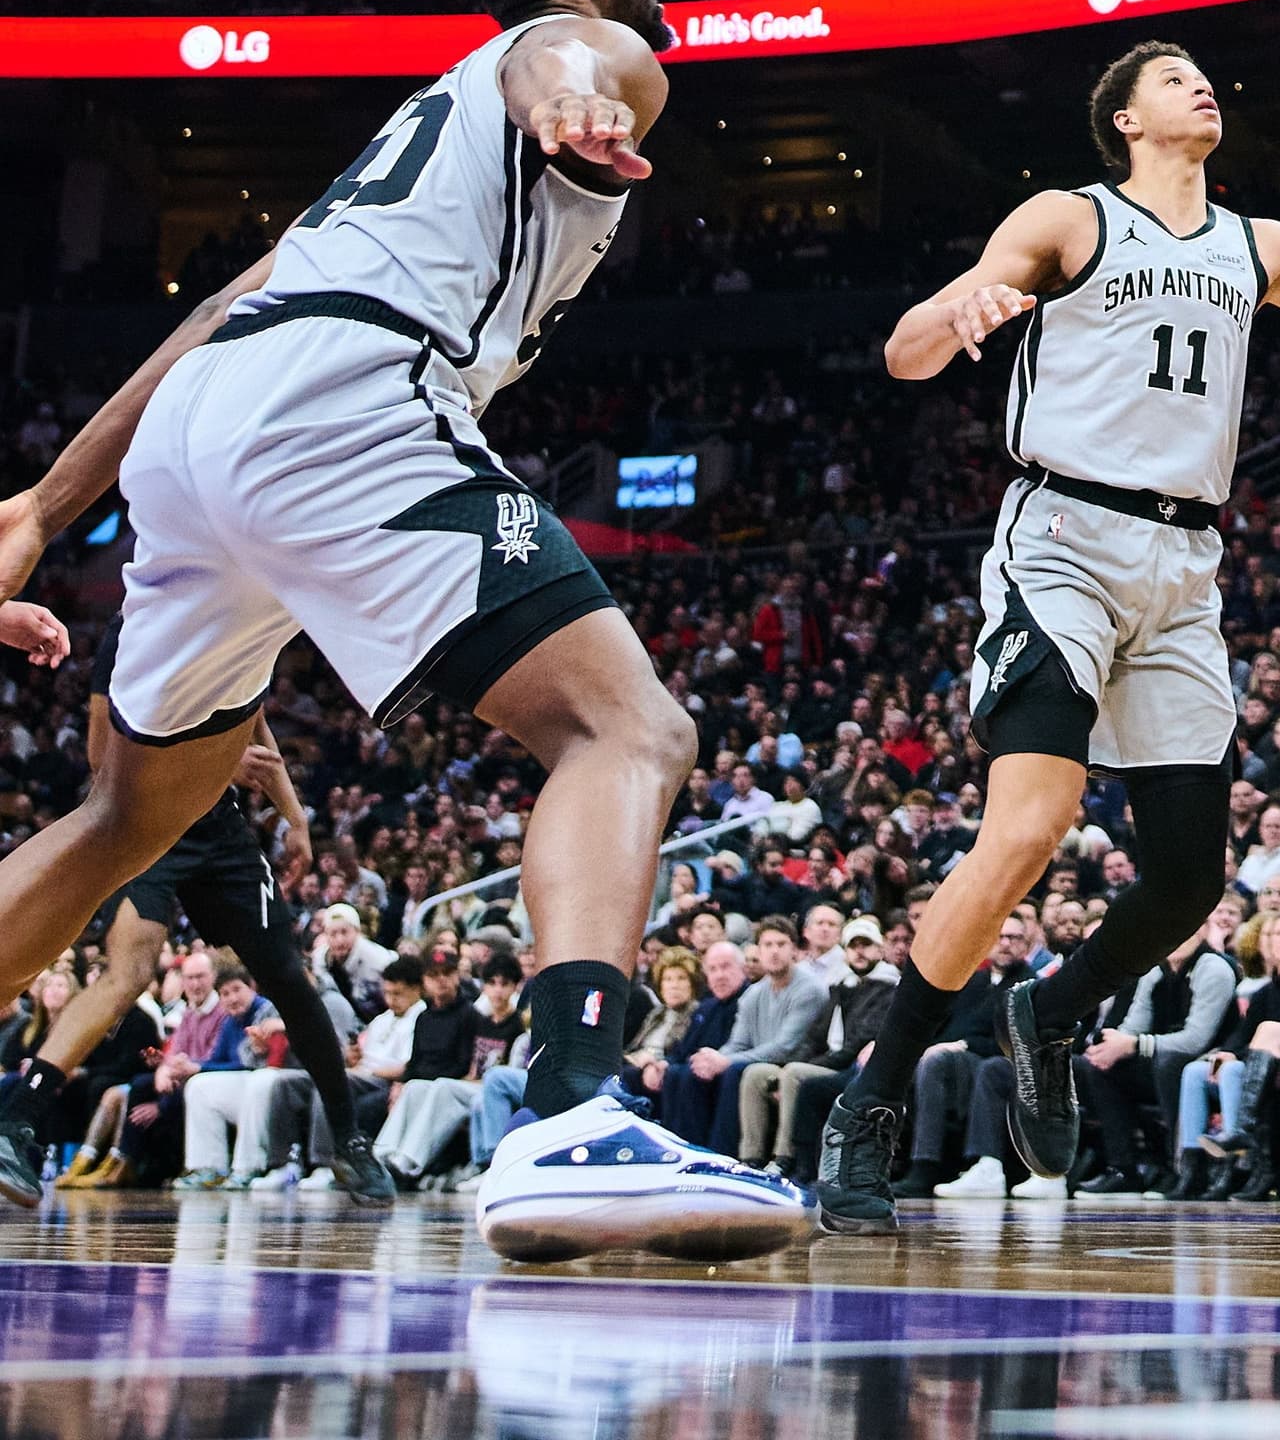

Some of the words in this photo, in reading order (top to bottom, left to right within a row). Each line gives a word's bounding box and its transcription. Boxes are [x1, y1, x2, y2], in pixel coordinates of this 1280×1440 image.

[224, 30, 270, 63] LG
[686, 12, 751, 47] Life's
[750, 6, 831, 42] Good.
[1104, 268, 1153, 313] SAN
[1161, 267, 1252, 333] ANTONIO
[1146, 323, 1209, 398] 11
